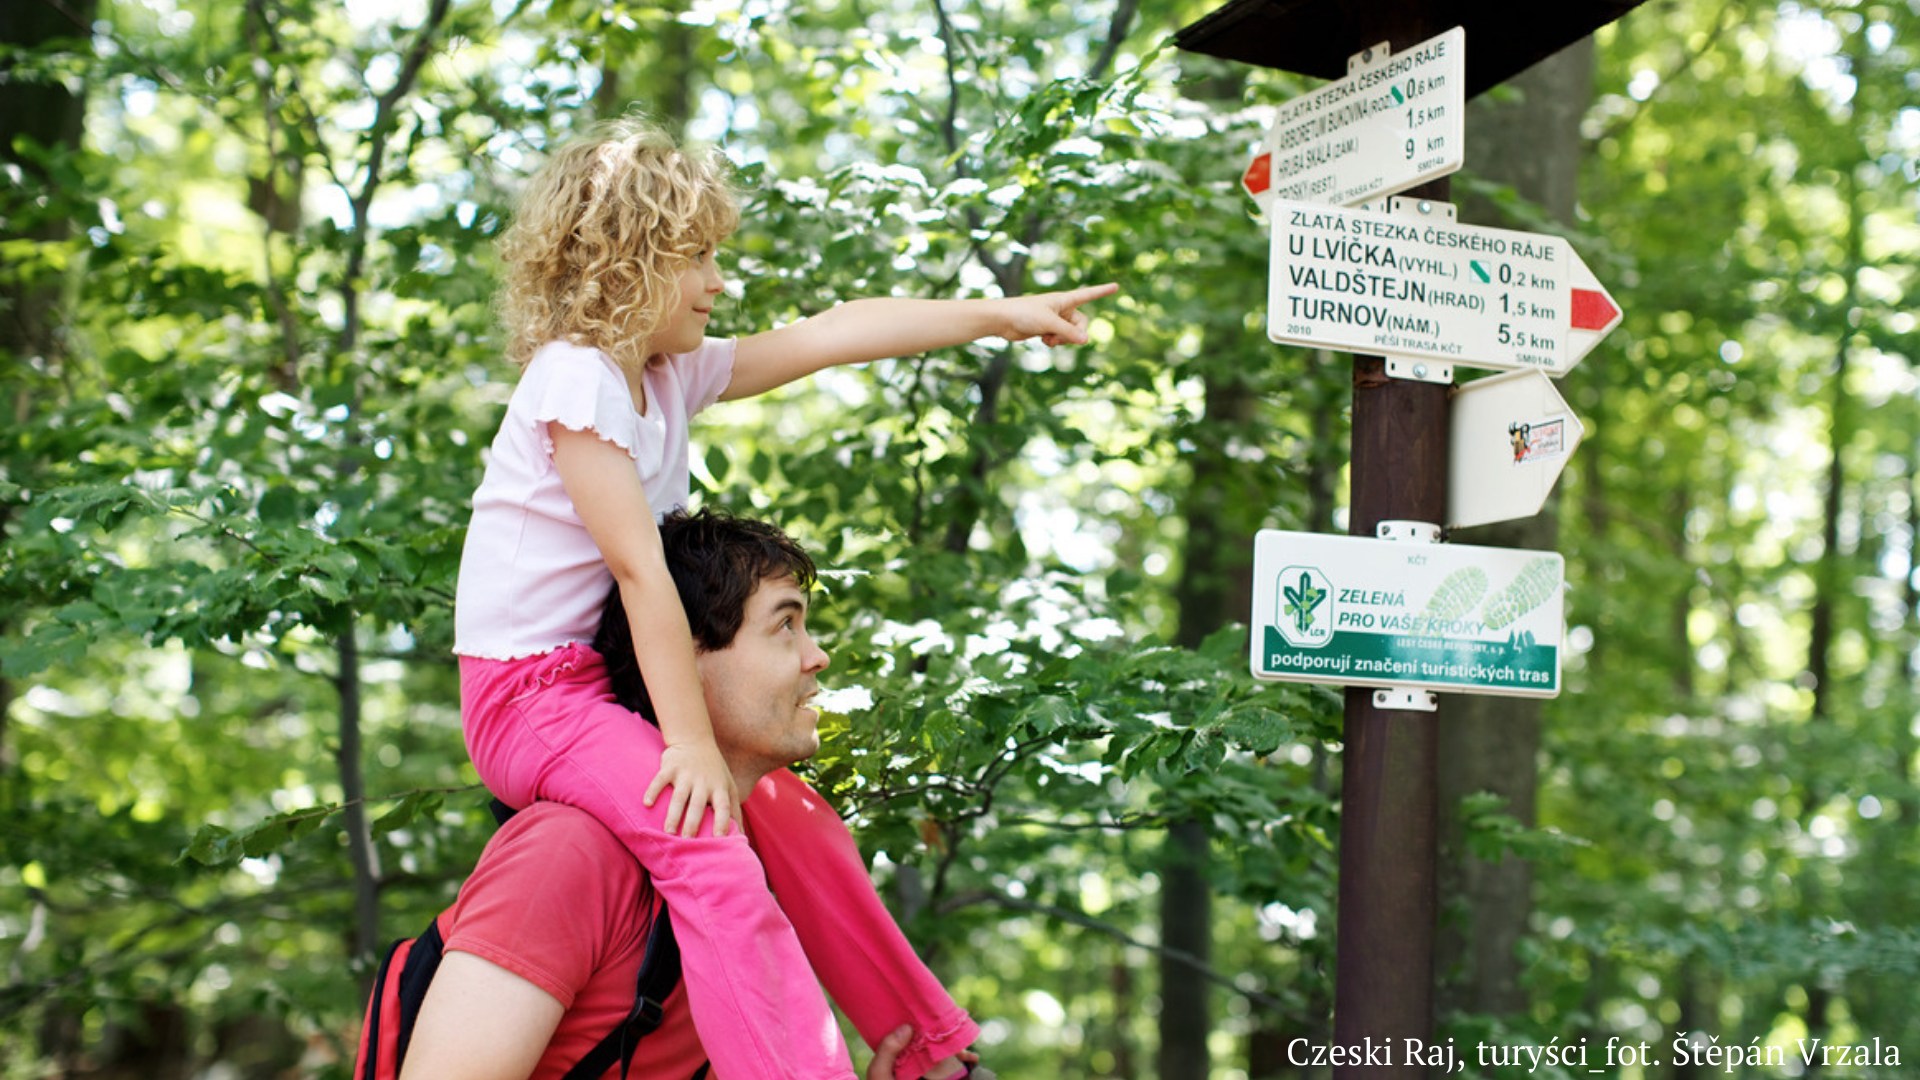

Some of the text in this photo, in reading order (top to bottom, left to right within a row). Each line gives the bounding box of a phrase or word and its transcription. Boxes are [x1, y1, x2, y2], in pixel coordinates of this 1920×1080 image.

[1406, 78, 1425, 99] 0,6
[1428, 76, 1445, 91] km
[1406, 107, 1425, 129] 1,5
[1428, 106, 1445, 121] km
[1405, 138, 1415, 160] 9
[1427, 137, 1444, 152] km
[1290, 211, 1555, 262] ZLATÁ STEZKA ČESKÉHO RÁJE
[1289, 234, 1304, 255] U
[1499, 263, 1526, 288] 0,2
[1531, 273, 1556, 291] km
[1499, 292, 1527, 317] 1,5
[1531, 303, 1556, 320] km
[1287, 323, 1312, 336] 2010
[1498, 323, 1526, 347] 5,5
[1530, 333, 1555, 350] km
[1402, 338, 1438, 351] TRASA
[1516, 353, 1555, 367] SM014b
[1338, 588, 1405, 607] ZELENÁ
[1338, 612, 1487, 635] PRO VAŠE KROKY
[1271, 652, 1550, 683] podporují značení turistických tras
